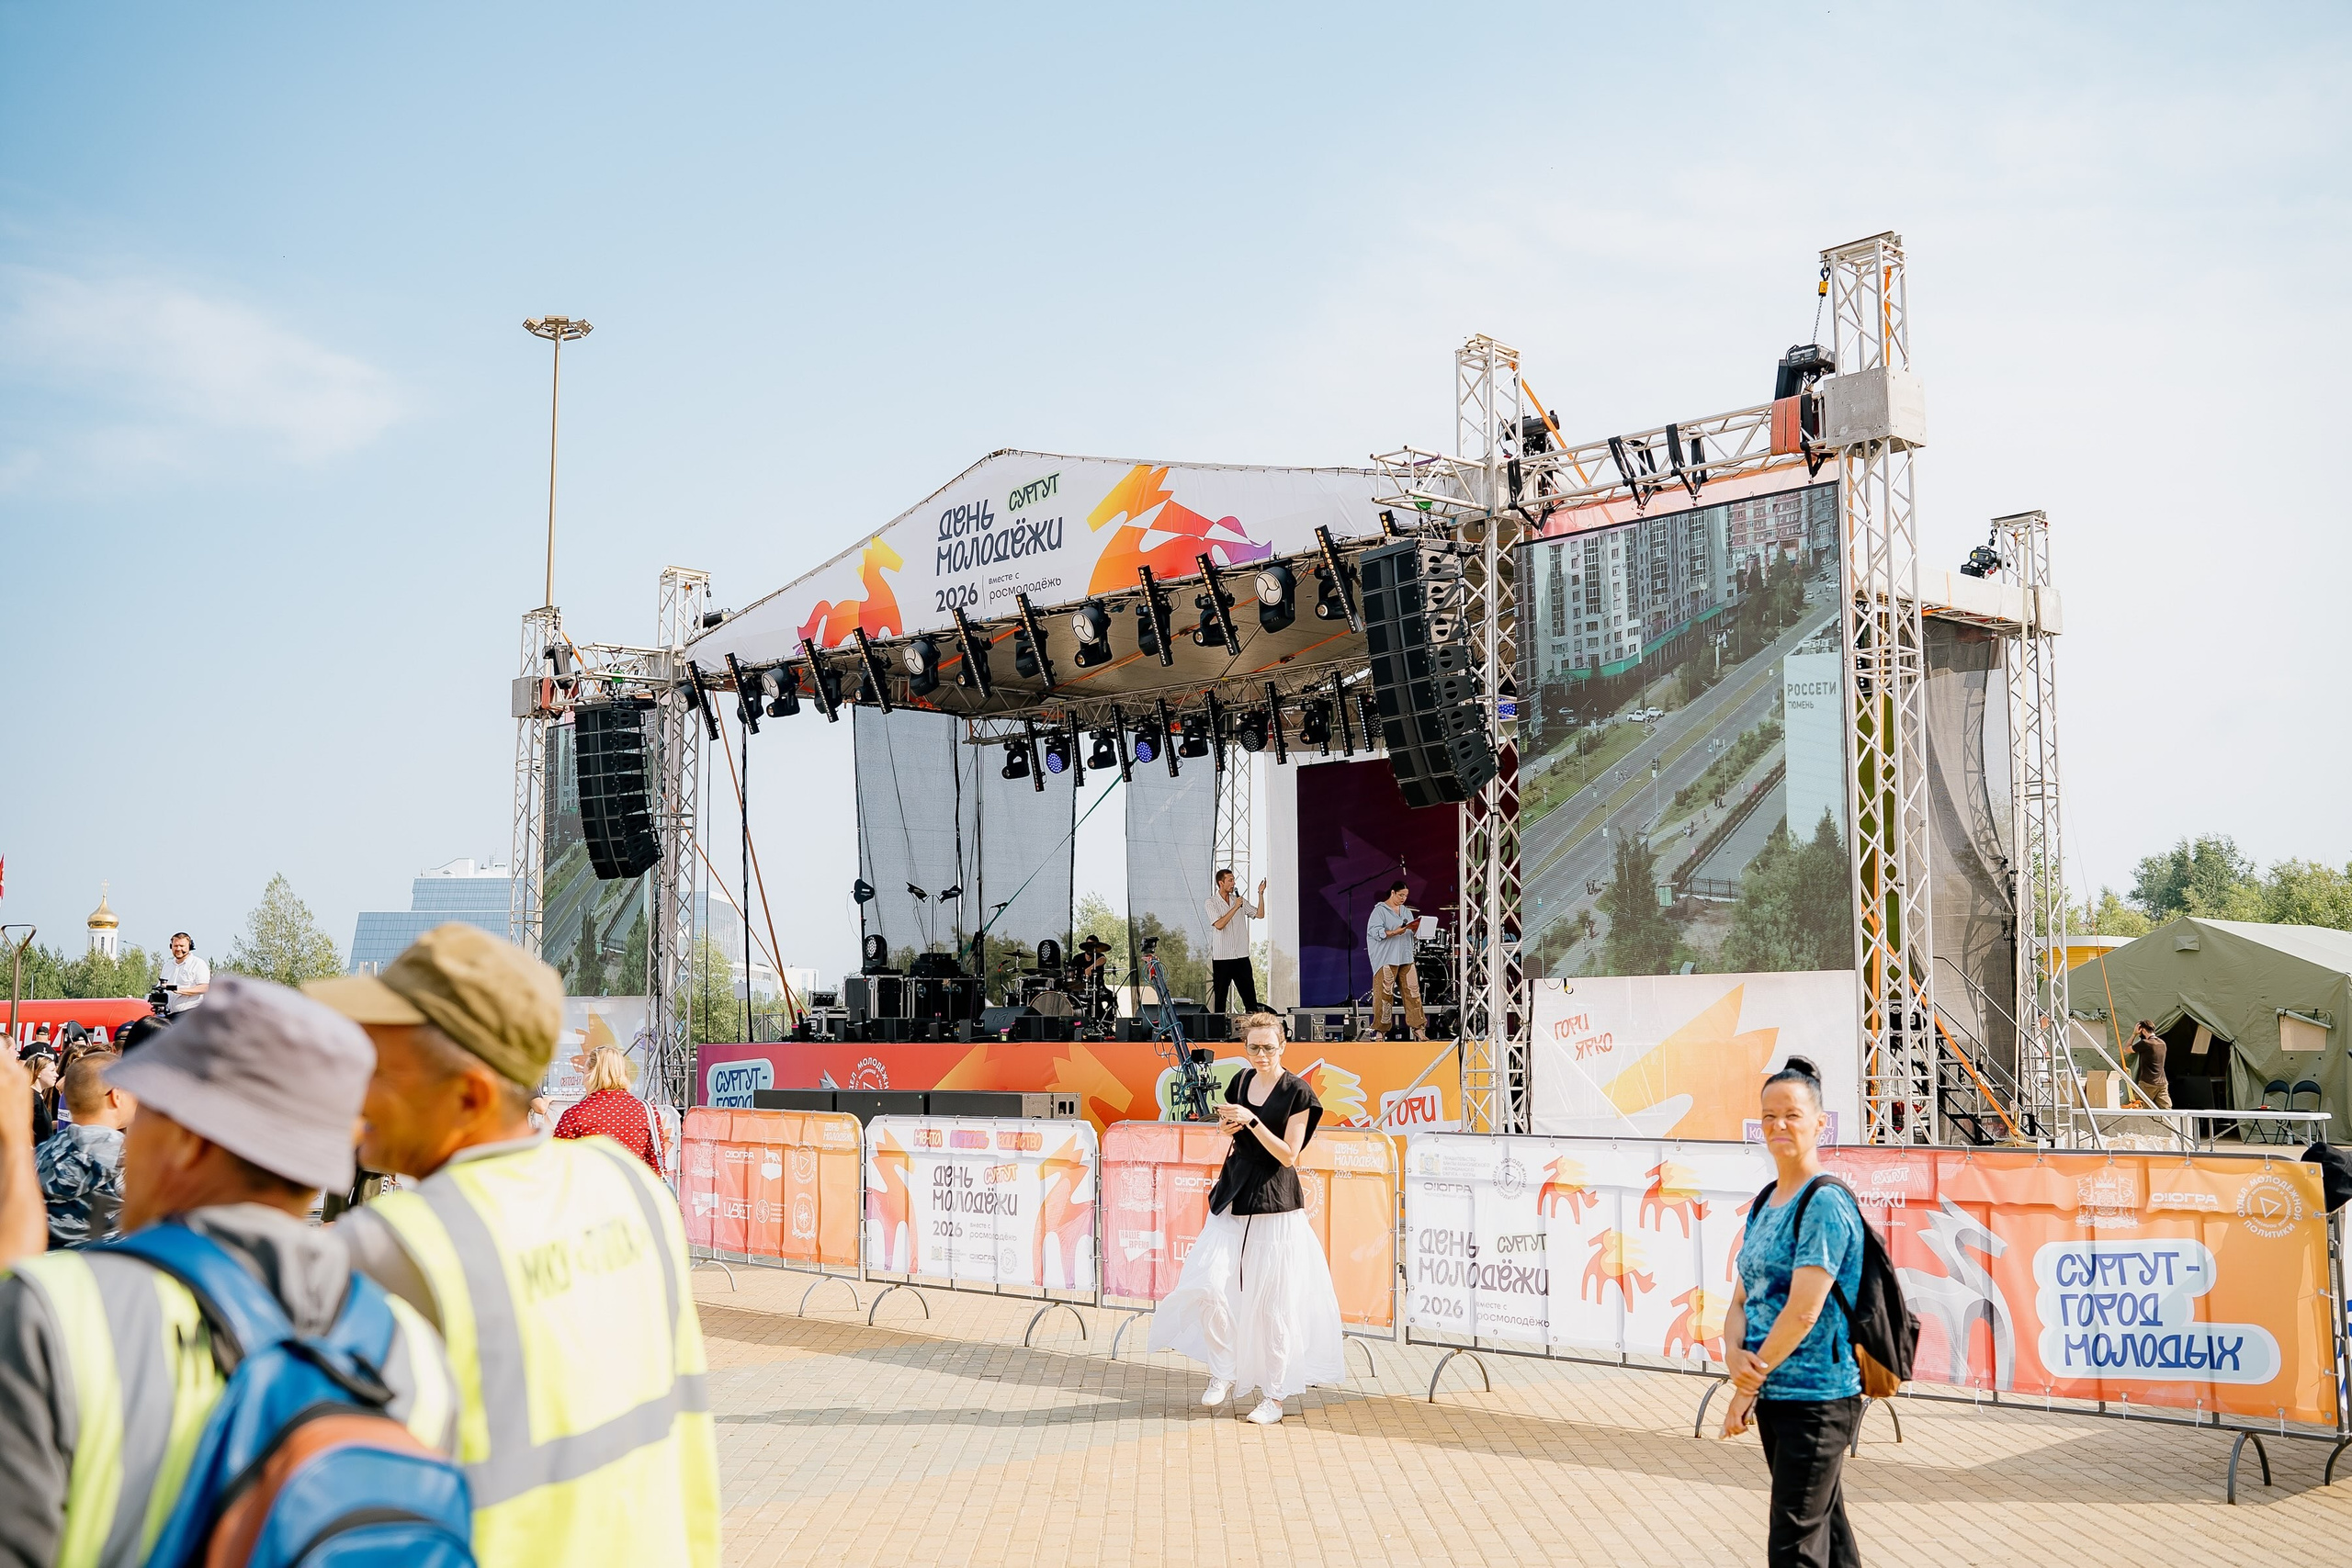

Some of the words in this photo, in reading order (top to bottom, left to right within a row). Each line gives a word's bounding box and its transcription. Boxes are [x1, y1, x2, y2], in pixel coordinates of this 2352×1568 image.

[1009, 472, 1060, 512] СУРГУТ
[988, 573, 1012, 585] вместе
[1015, 571, 1020, 580] с
[989, 577, 1062, 605] росмолодёжь
[935, 582, 978, 613] 2026
[1787, 682, 1837, 696] РОССЕТИ
[1787, 700, 1815, 710] ТЮМЕНЬ
[1554, 1013, 1589, 1041] ГОРИ
[1575, 1032, 1613, 1061] ЯРКО
[1386, 1094, 1437, 1127] ГОРИ
[1333, 1169, 1352, 1179] 2026
[2236, 1187, 2248, 1218] ОТДЕЛ
[2249, 1175, 2303, 1222] МОЛОДЁЖНОЙ
[933, 1220, 963, 1237] 2026
[2243, 1219, 2296, 1238] ПОЛИТИКИ
[1497, 1233, 1547, 1254] СУРГУТ
[1419, 1295, 1464, 1319] 2026
[1476, 1301, 1501, 1310] вместе
[2060, 1292, 2164, 1327] ГОРОД
[2064, 1333, 2244, 1371] МОЛОДЫХ
